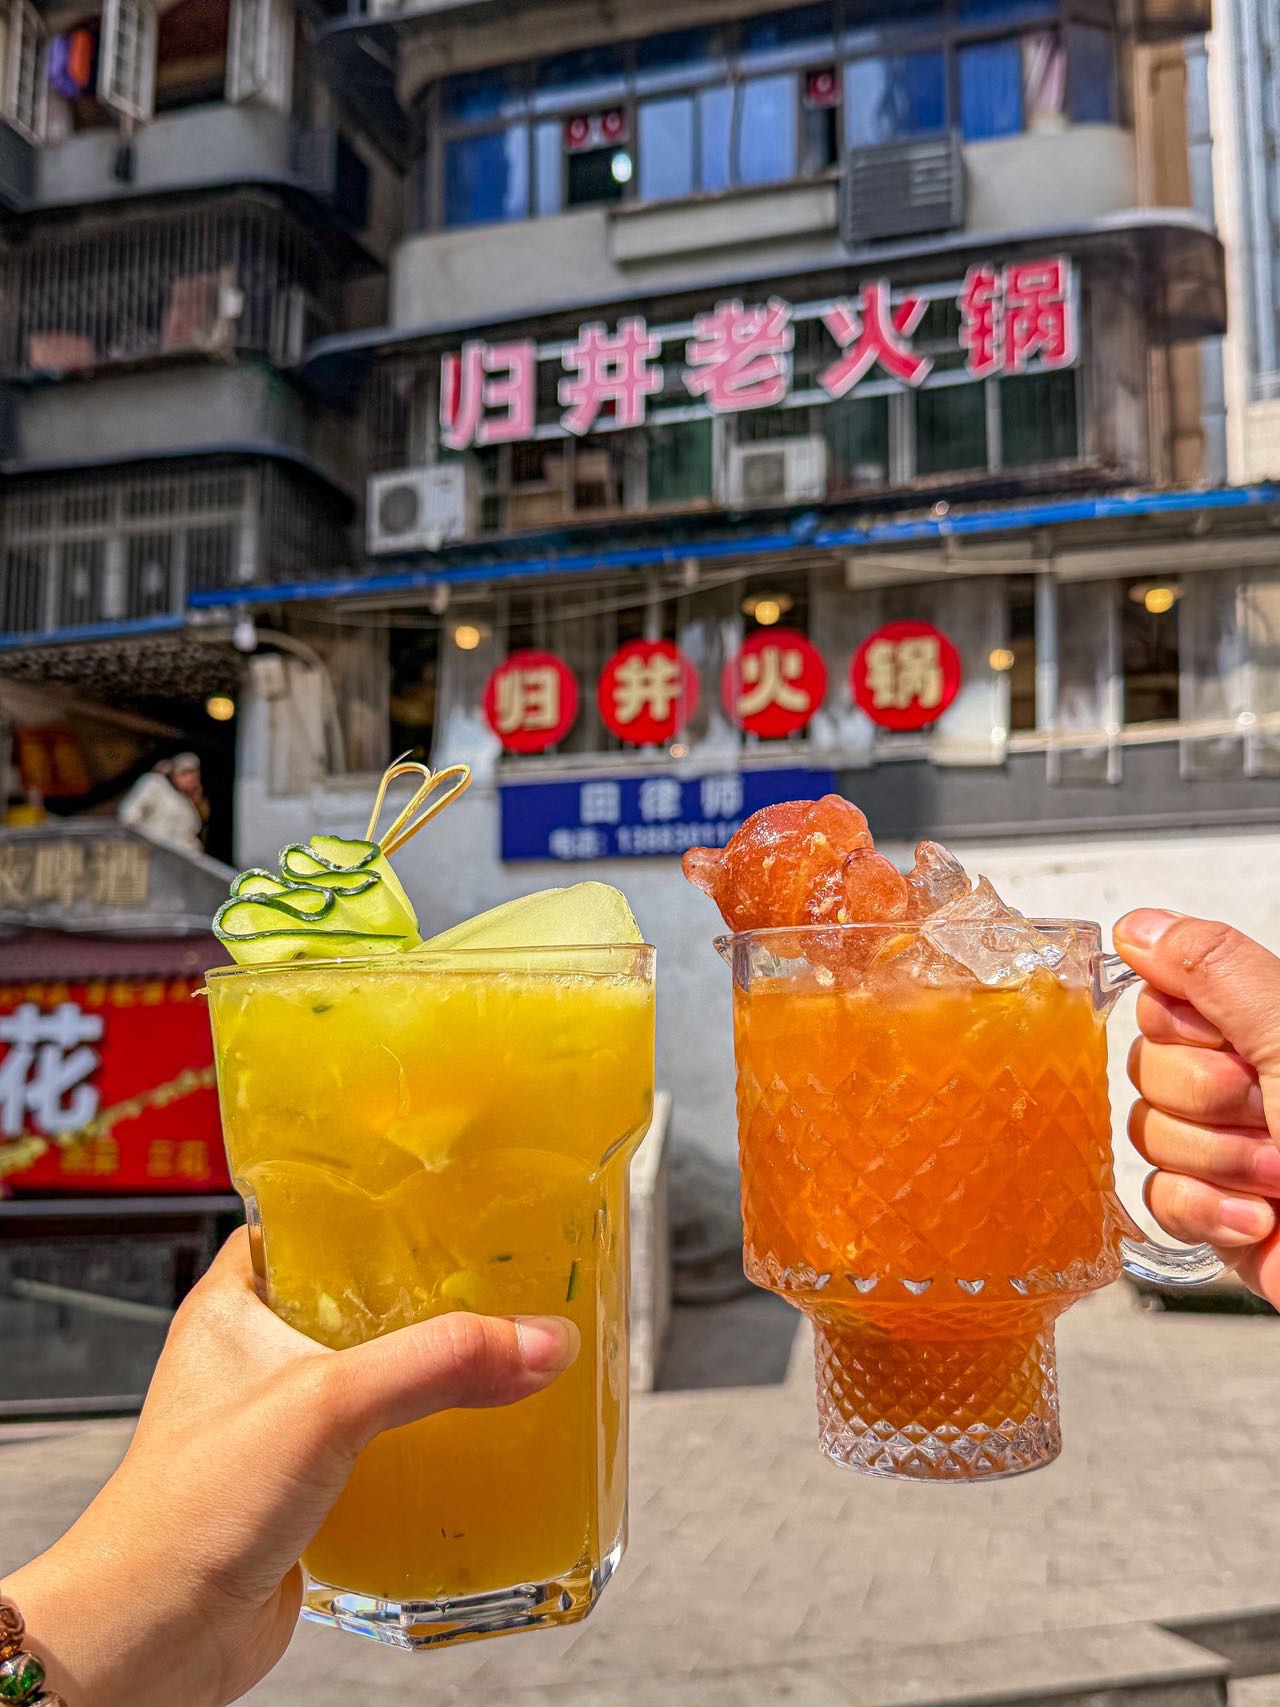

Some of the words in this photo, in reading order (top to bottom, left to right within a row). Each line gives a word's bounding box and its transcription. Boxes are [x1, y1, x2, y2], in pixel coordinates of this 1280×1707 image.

[440, 256, 1079, 450] 归井老火锅
[495, 637, 944, 733] 归井火锅
[0, 1003, 103, 1137] 花
